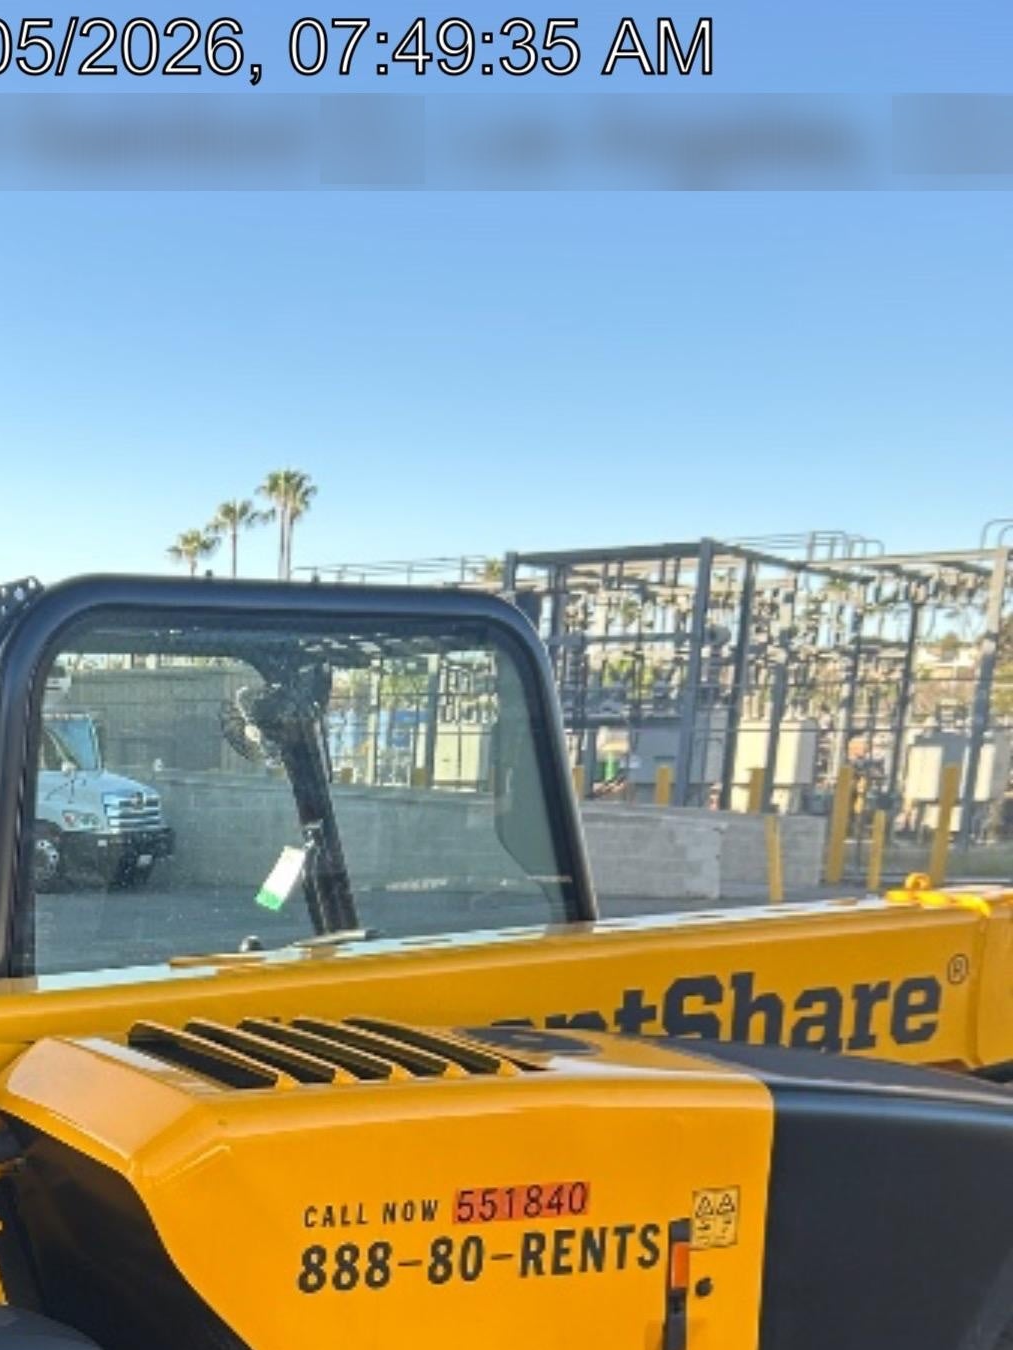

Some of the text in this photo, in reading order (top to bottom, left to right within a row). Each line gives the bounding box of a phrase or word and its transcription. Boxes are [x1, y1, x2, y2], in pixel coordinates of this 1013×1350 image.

[303, 1199, 438, 1228] CALL NOW
[456, 1181, 588, 1223] 551840
[297, 1222, 661, 1293] 888-80-RENTS
